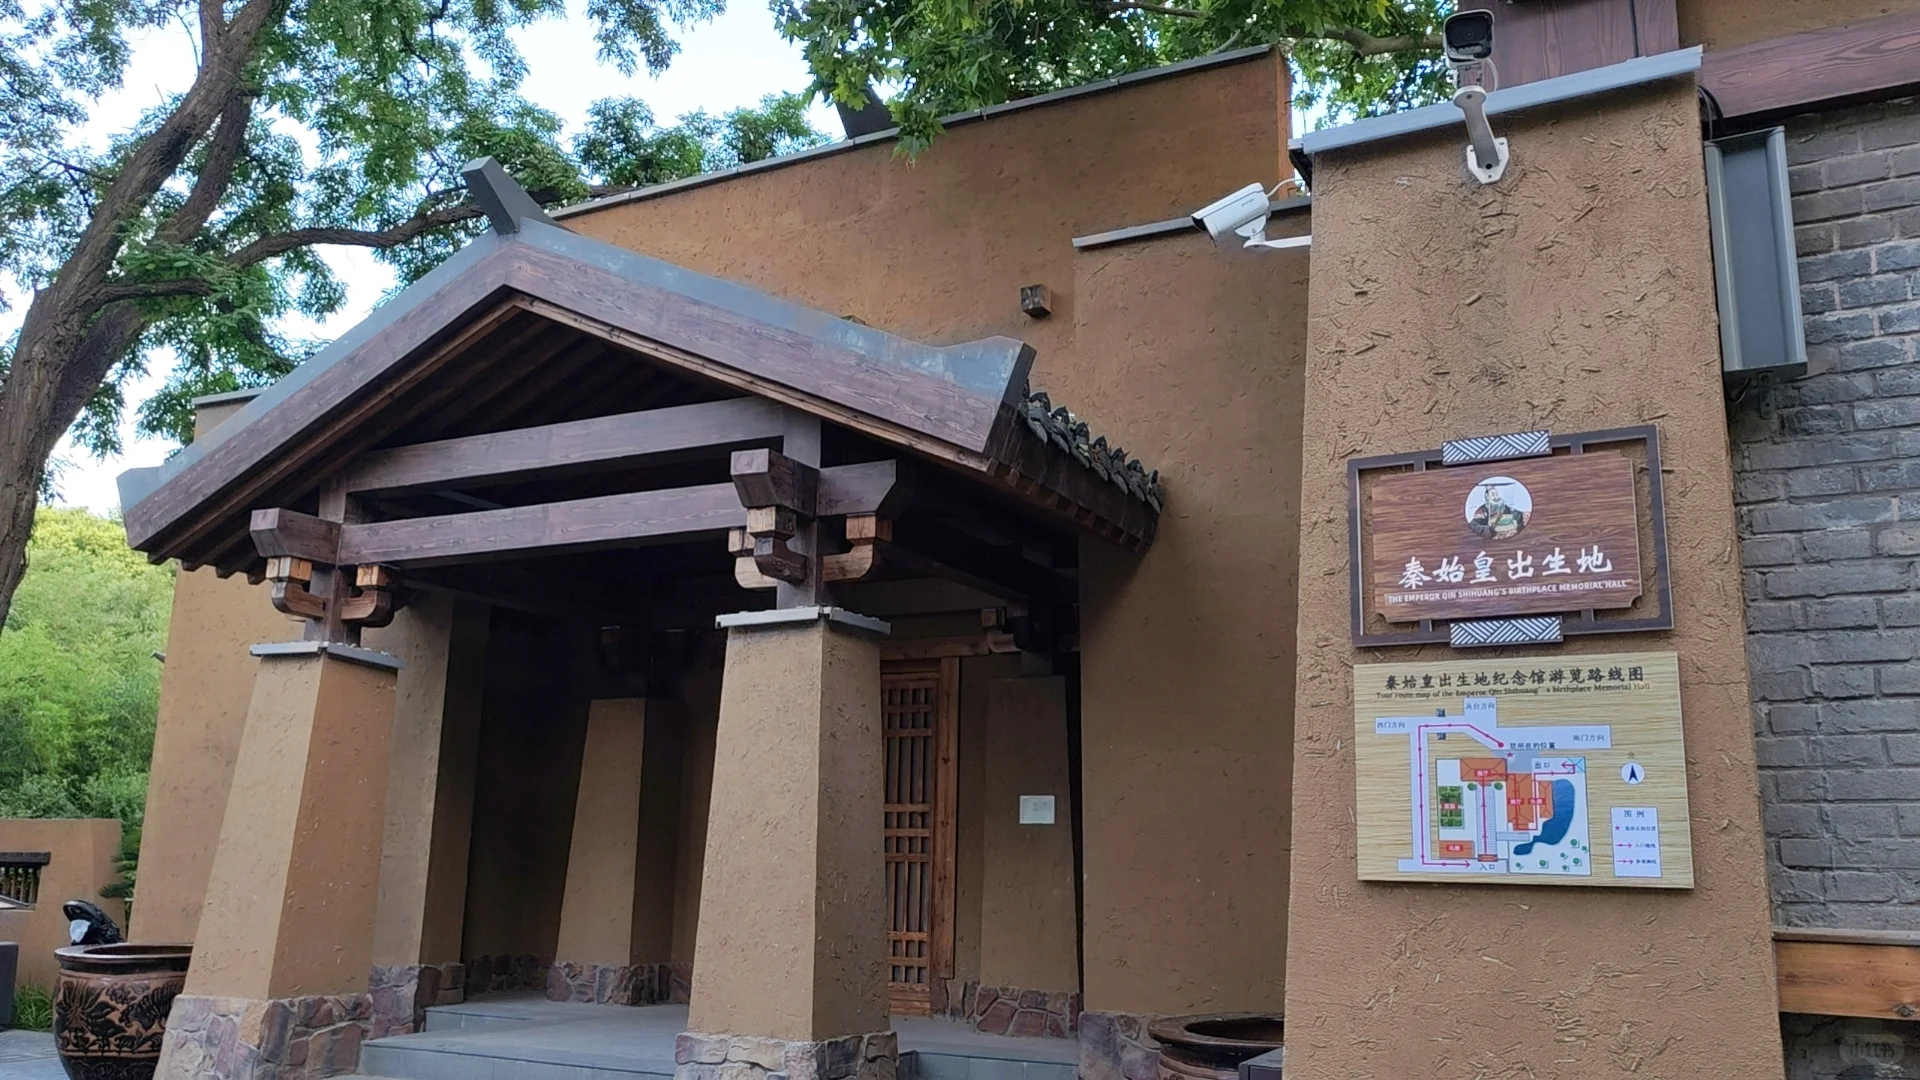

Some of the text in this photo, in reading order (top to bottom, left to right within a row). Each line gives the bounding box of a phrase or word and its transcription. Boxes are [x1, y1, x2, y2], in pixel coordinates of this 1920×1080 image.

[1398, 545, 1613, 589] 秦始皇出生地
[1388, 580, 1628, 604] THE EMPEROR QIN SHIHUANG'S BIRTHPLACE MEMORIAL HALL
[1385, 666, 1643, 690] 秦始皇出生地纪念馆游览路线图
[1456, 690, 1486, 698] Emperor
[1552, 685, 1592, 693] birthplace
[1594, 683, 1631, 691] Memorial
[1377, 721, 1405, 729] 西门方向
[1572, 734, 1604, 742] 南门方向
[1510, 741, 1556, 749] 您所在的位置
[1624, 810, 1644, 818] 图例
